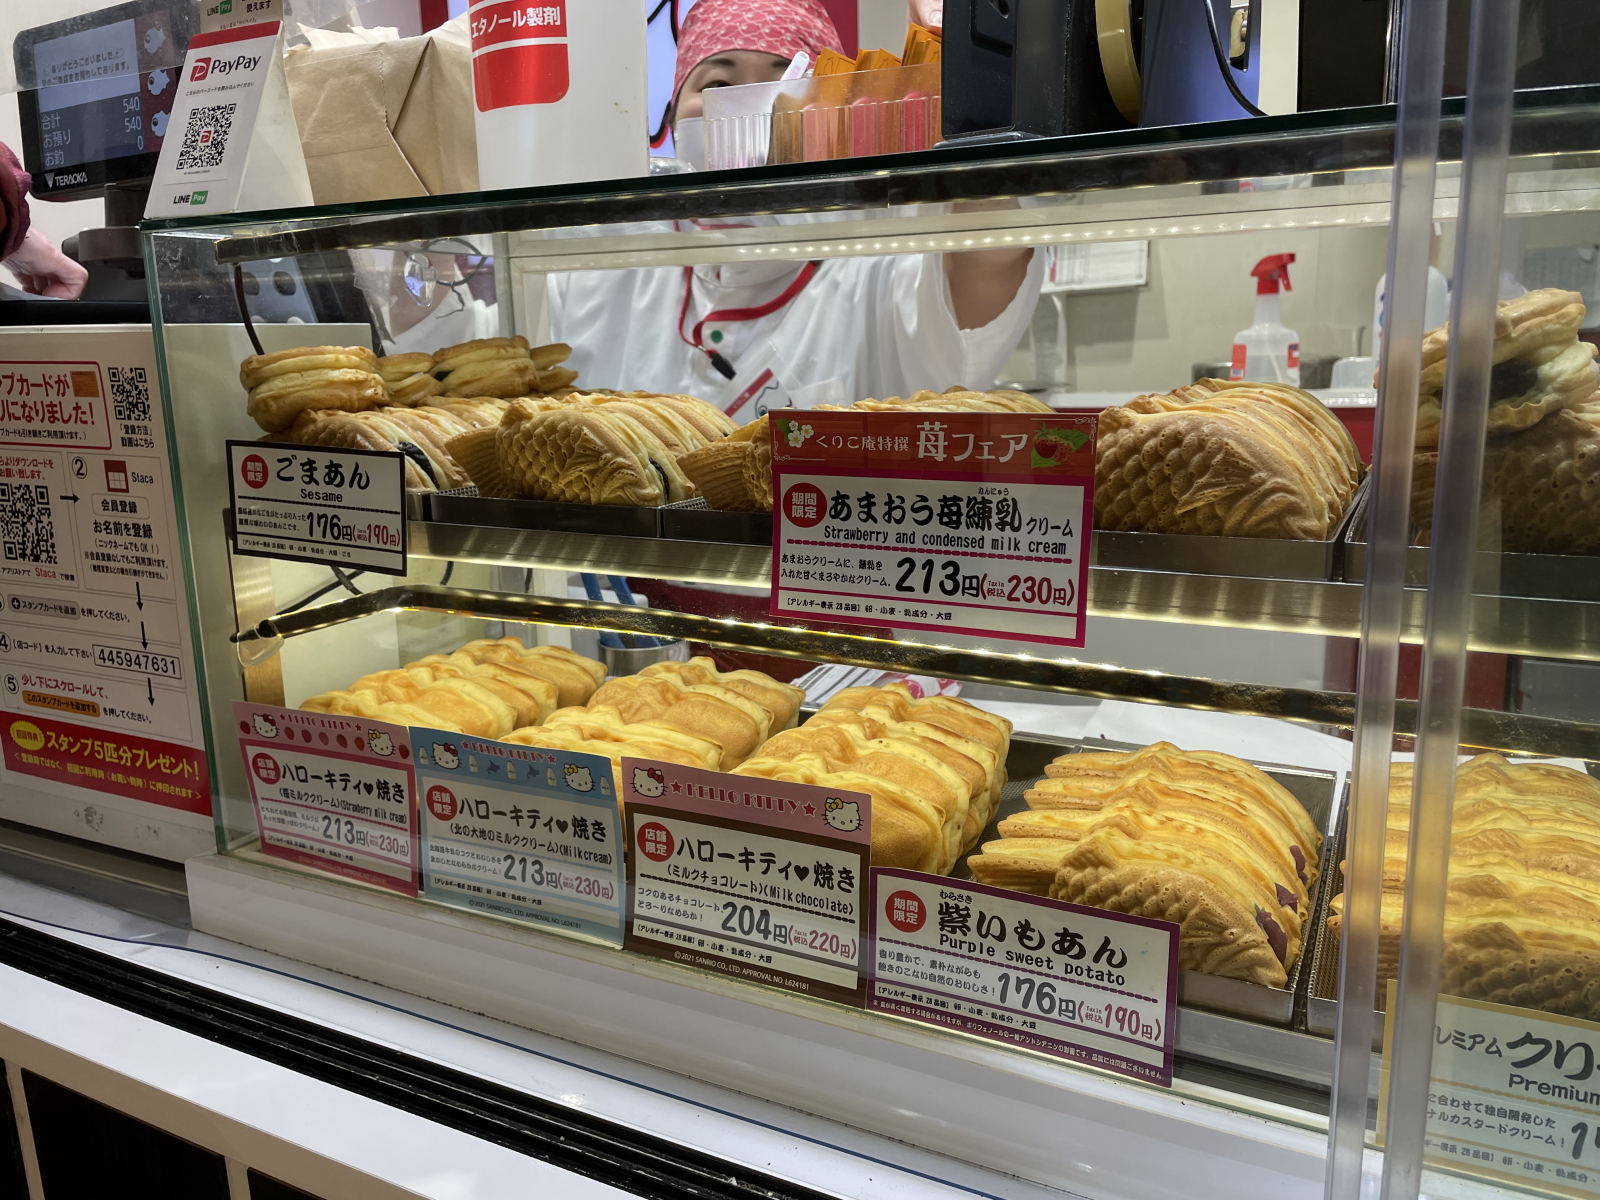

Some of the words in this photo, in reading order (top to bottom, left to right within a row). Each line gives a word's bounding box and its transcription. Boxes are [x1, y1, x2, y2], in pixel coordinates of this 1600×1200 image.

[207, 6, 219, 16] LINE
[247, 1, 271, 13] 使えます
[472, 6, 560, 38] エタノール製剤
[211, 56, 261, 75] PayPay
[41, 115, 60, 129] 合計
[123, 97, 139, 113] 540
[43, 130, 71, 148] お預り
[124, 115, 141, 133] 540
[45, 151, 64, 166] お釣
[137, 136, 143, 150] 0
[55, 172, 88, 186] TERAOKA
[173, 195, 190, 204] LINE
[0, 372, 70, 397] プカードが
[121, 436, 154, 448] 動画はこちら
[816, 436, 909, 452] くりこ庵特撰
[916, 421, 1029, 463] 苺フェア
[247, 462, 262, 471] 期間
[276, 455, 370, 490] ごまあん
[132, 472, 153, 484] Staca
[247, 472, 263, 482] 限定
[300, 489, 343, 502] Sesame
[978, 487, 1009, 496] れんにゅう
[791, 492, 817, 506] 期間
[101, 499, 137, 514] 会員登録
[792, 506, 817, 519] 限定
[93, 520, 153, 539] お名前を登録
[824, 525, 889, 544] Strawberry
[895, 533, 915, 545] and
[922, 534, 984, 550] condensed
[991, 538, 1020, 551] milk
[1028, 541, 1066, 555] cream
[35, 567, 56, 578] Staca
[81, 608, 130, 622] を押してください。
[98, 649, 176, 675] 445947631
[103, 708, 151, 723] を押してください。
[46, 731, 199, 780] スタンプ5匹分プレゼント！
[257, 758, 274, 769] 店舗
[259, 769, 276, 780] 限定
[432, 791, 451, 803] 店舗
[686, 784, 740, 804] HELLO
[744, 793, 801, 814] KITTY
[374, 806, 387, 818] milk
[434, 803, 452, 815] 限定
[645, 828, 666, 843] 店舗
[646, 842, 667, 856] 限定
[939, 890, 973, 904] むらさき
[894, 897, 918, 912] 期間
[894, 910, 918, 924] 限定
[937, 901, 1127, 969] 紫いもあん
[939, 933, 995, 957] Purple
[1005, 949, 1053, 970] sweet
[1064, 962, 1125, 986] potato
[696, 956, 717, 969] SANRIO
[742, 968, 772, 982] APPROVAL
[773, 975, 784, 985] NO.
[785, 977, 809, 990] L624181
[878, 962, 995, 997] 飽きのこない自然のおいしさ！
[1571, 1122, 1600, 1160] 1
